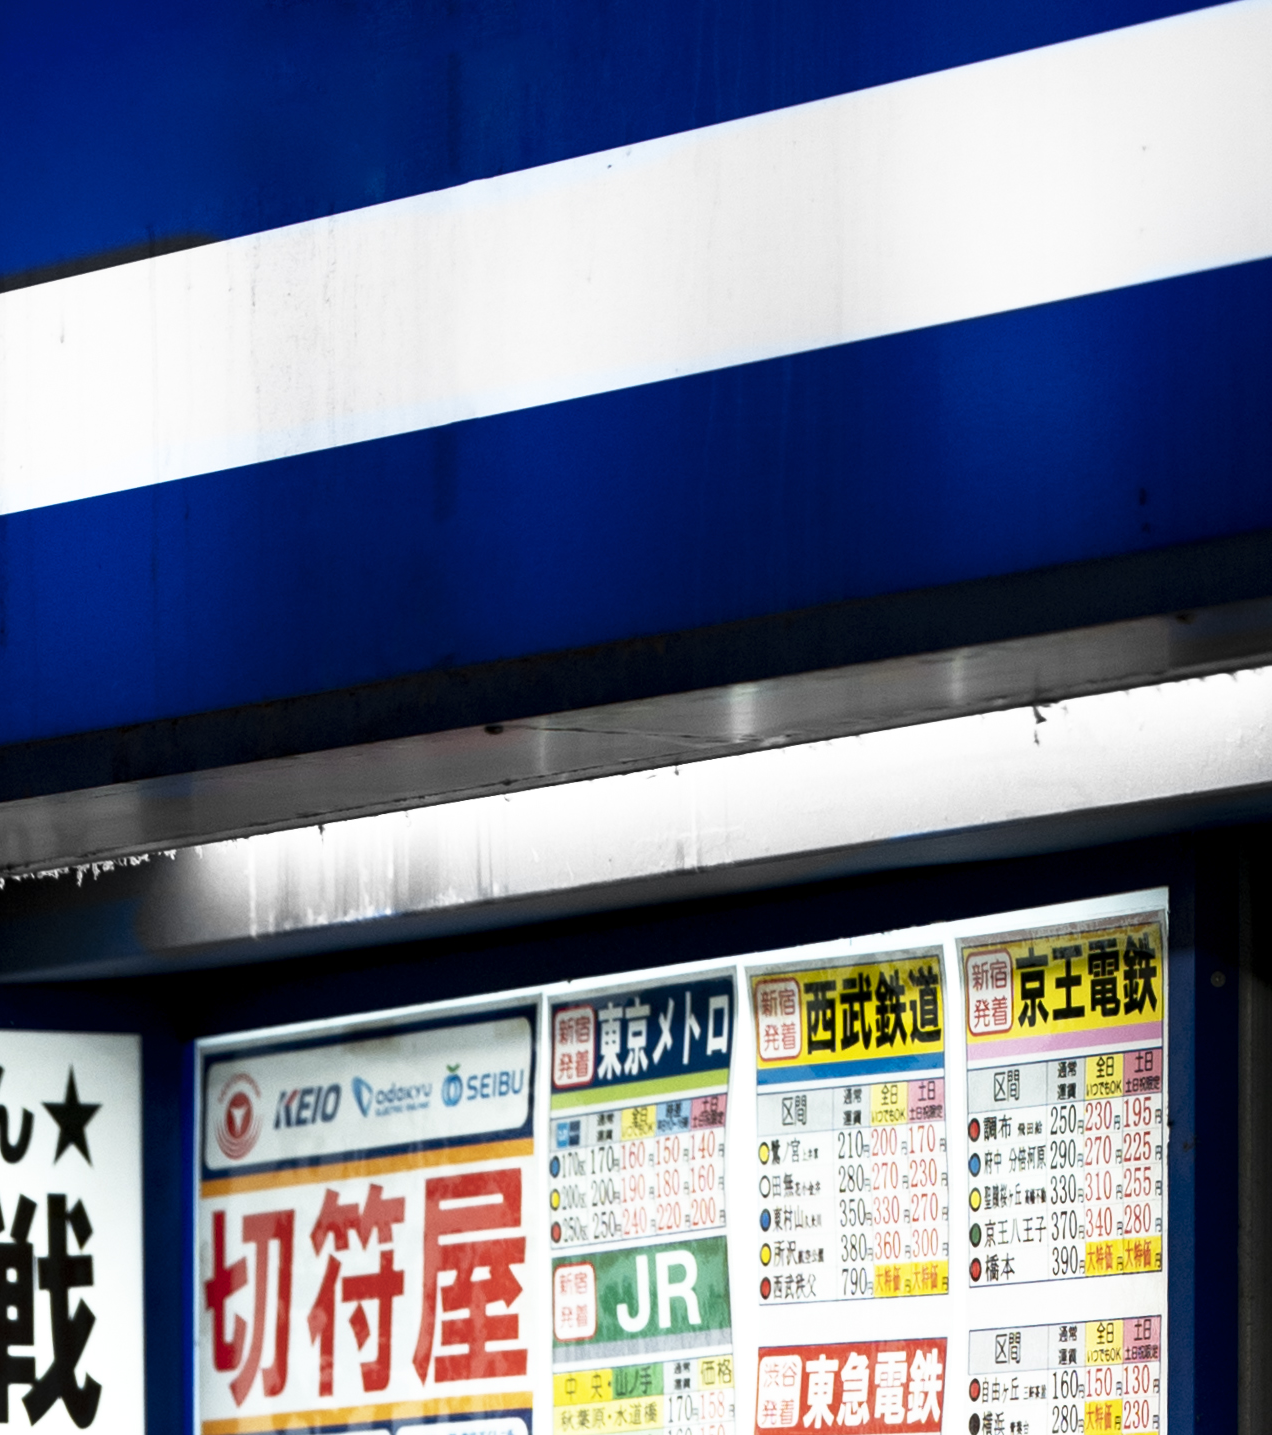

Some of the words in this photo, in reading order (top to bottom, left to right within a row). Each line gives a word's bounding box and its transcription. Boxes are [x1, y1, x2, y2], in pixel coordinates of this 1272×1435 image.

[805, 965, 943, 1056] 西武鉄道
[1013, 931, 1160, 1029] 京王電鉄
[597, 990, 730, 1081] 東京メトロ
[274, 1083, 341, 1130] KEIO
[375, 1082, 433, 1106] odakyu
[466, 1068, 525, 1101] SEIBU
[993, 1068, 1021, 1101] 区間
[984, 1216, 1047, 1248] 京王八王子
[984, 1253, 1015, 1282] 橋本
[204, 1168, 528, 1408] 切符屋
[615, 1248, 703, 1333] JR
[802, 1346, 944, 1431] 東急電鉄
